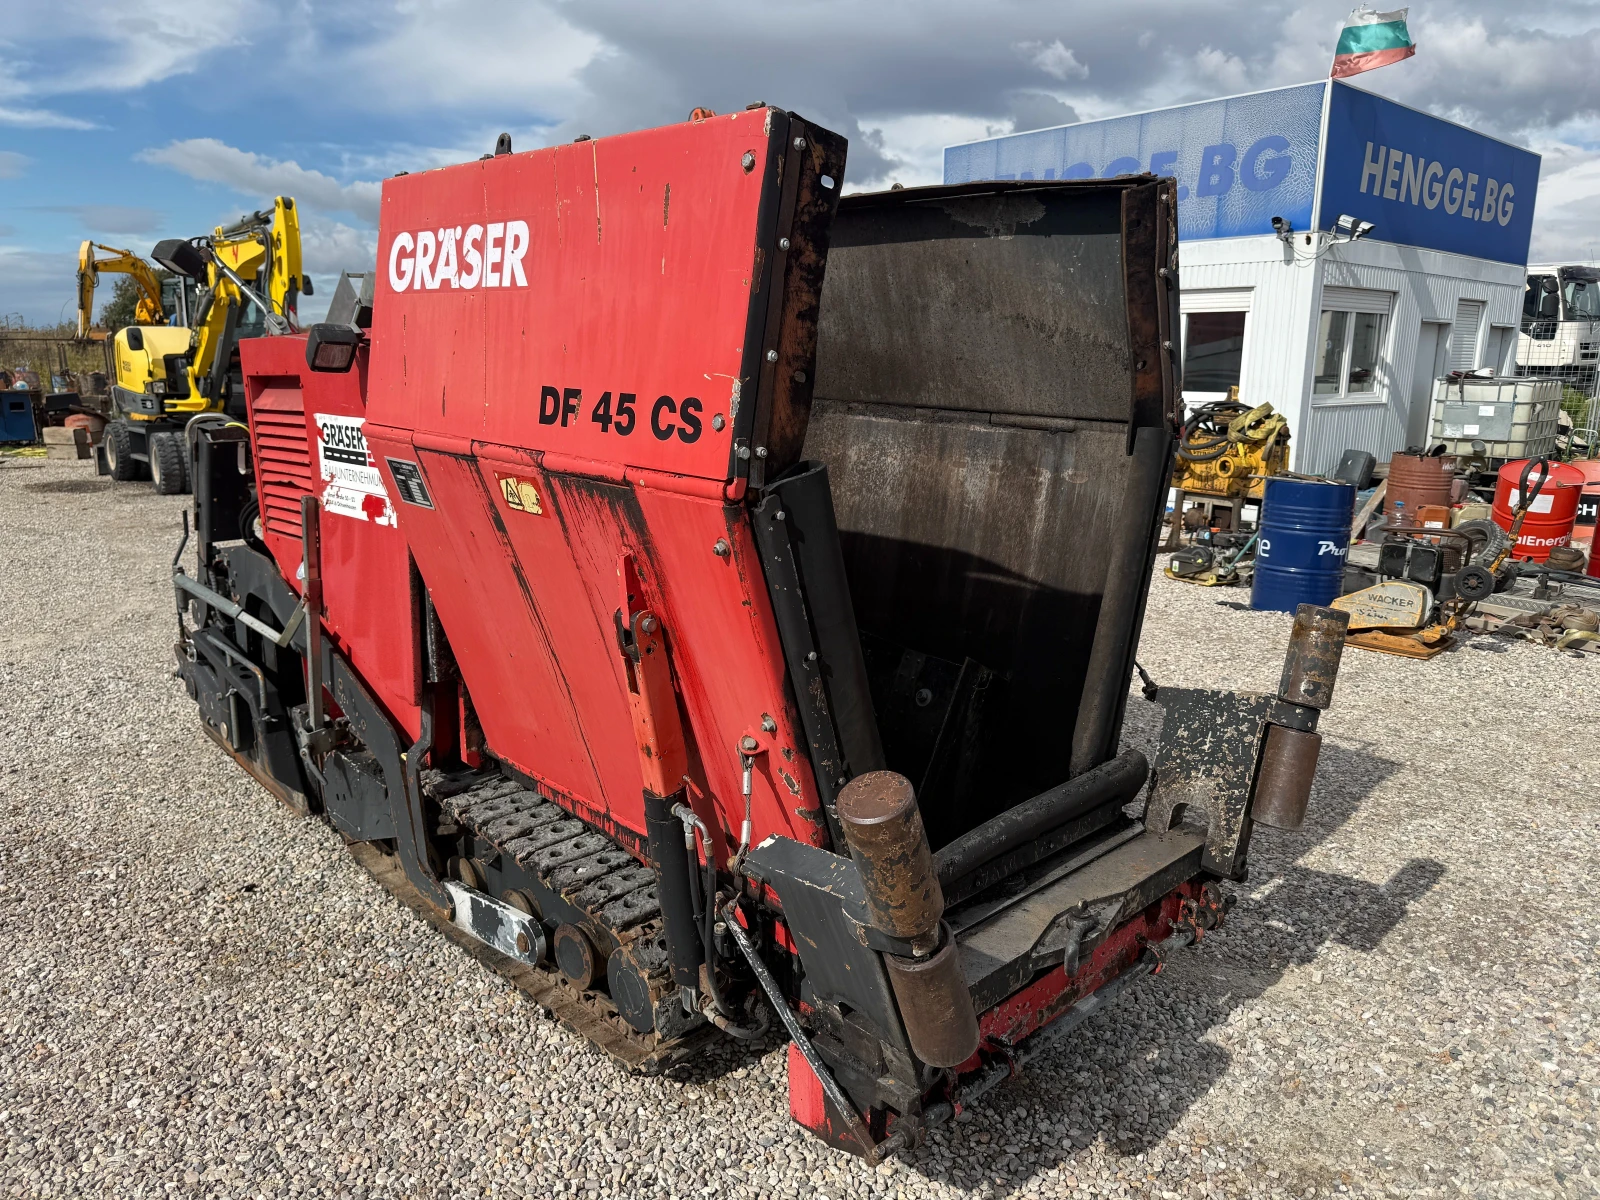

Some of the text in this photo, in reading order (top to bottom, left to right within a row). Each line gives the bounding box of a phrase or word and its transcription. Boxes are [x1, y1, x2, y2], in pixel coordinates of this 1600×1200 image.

[1359, 140, 1515, 227] HENGGE.BG
[388, 219, 530, 293] GRÄSER
[321, 422, 365, 451] GRÄSER
[538, 385, 704, 444] DF 45 CS
[1367, 592, 1415, 608] WACKER
